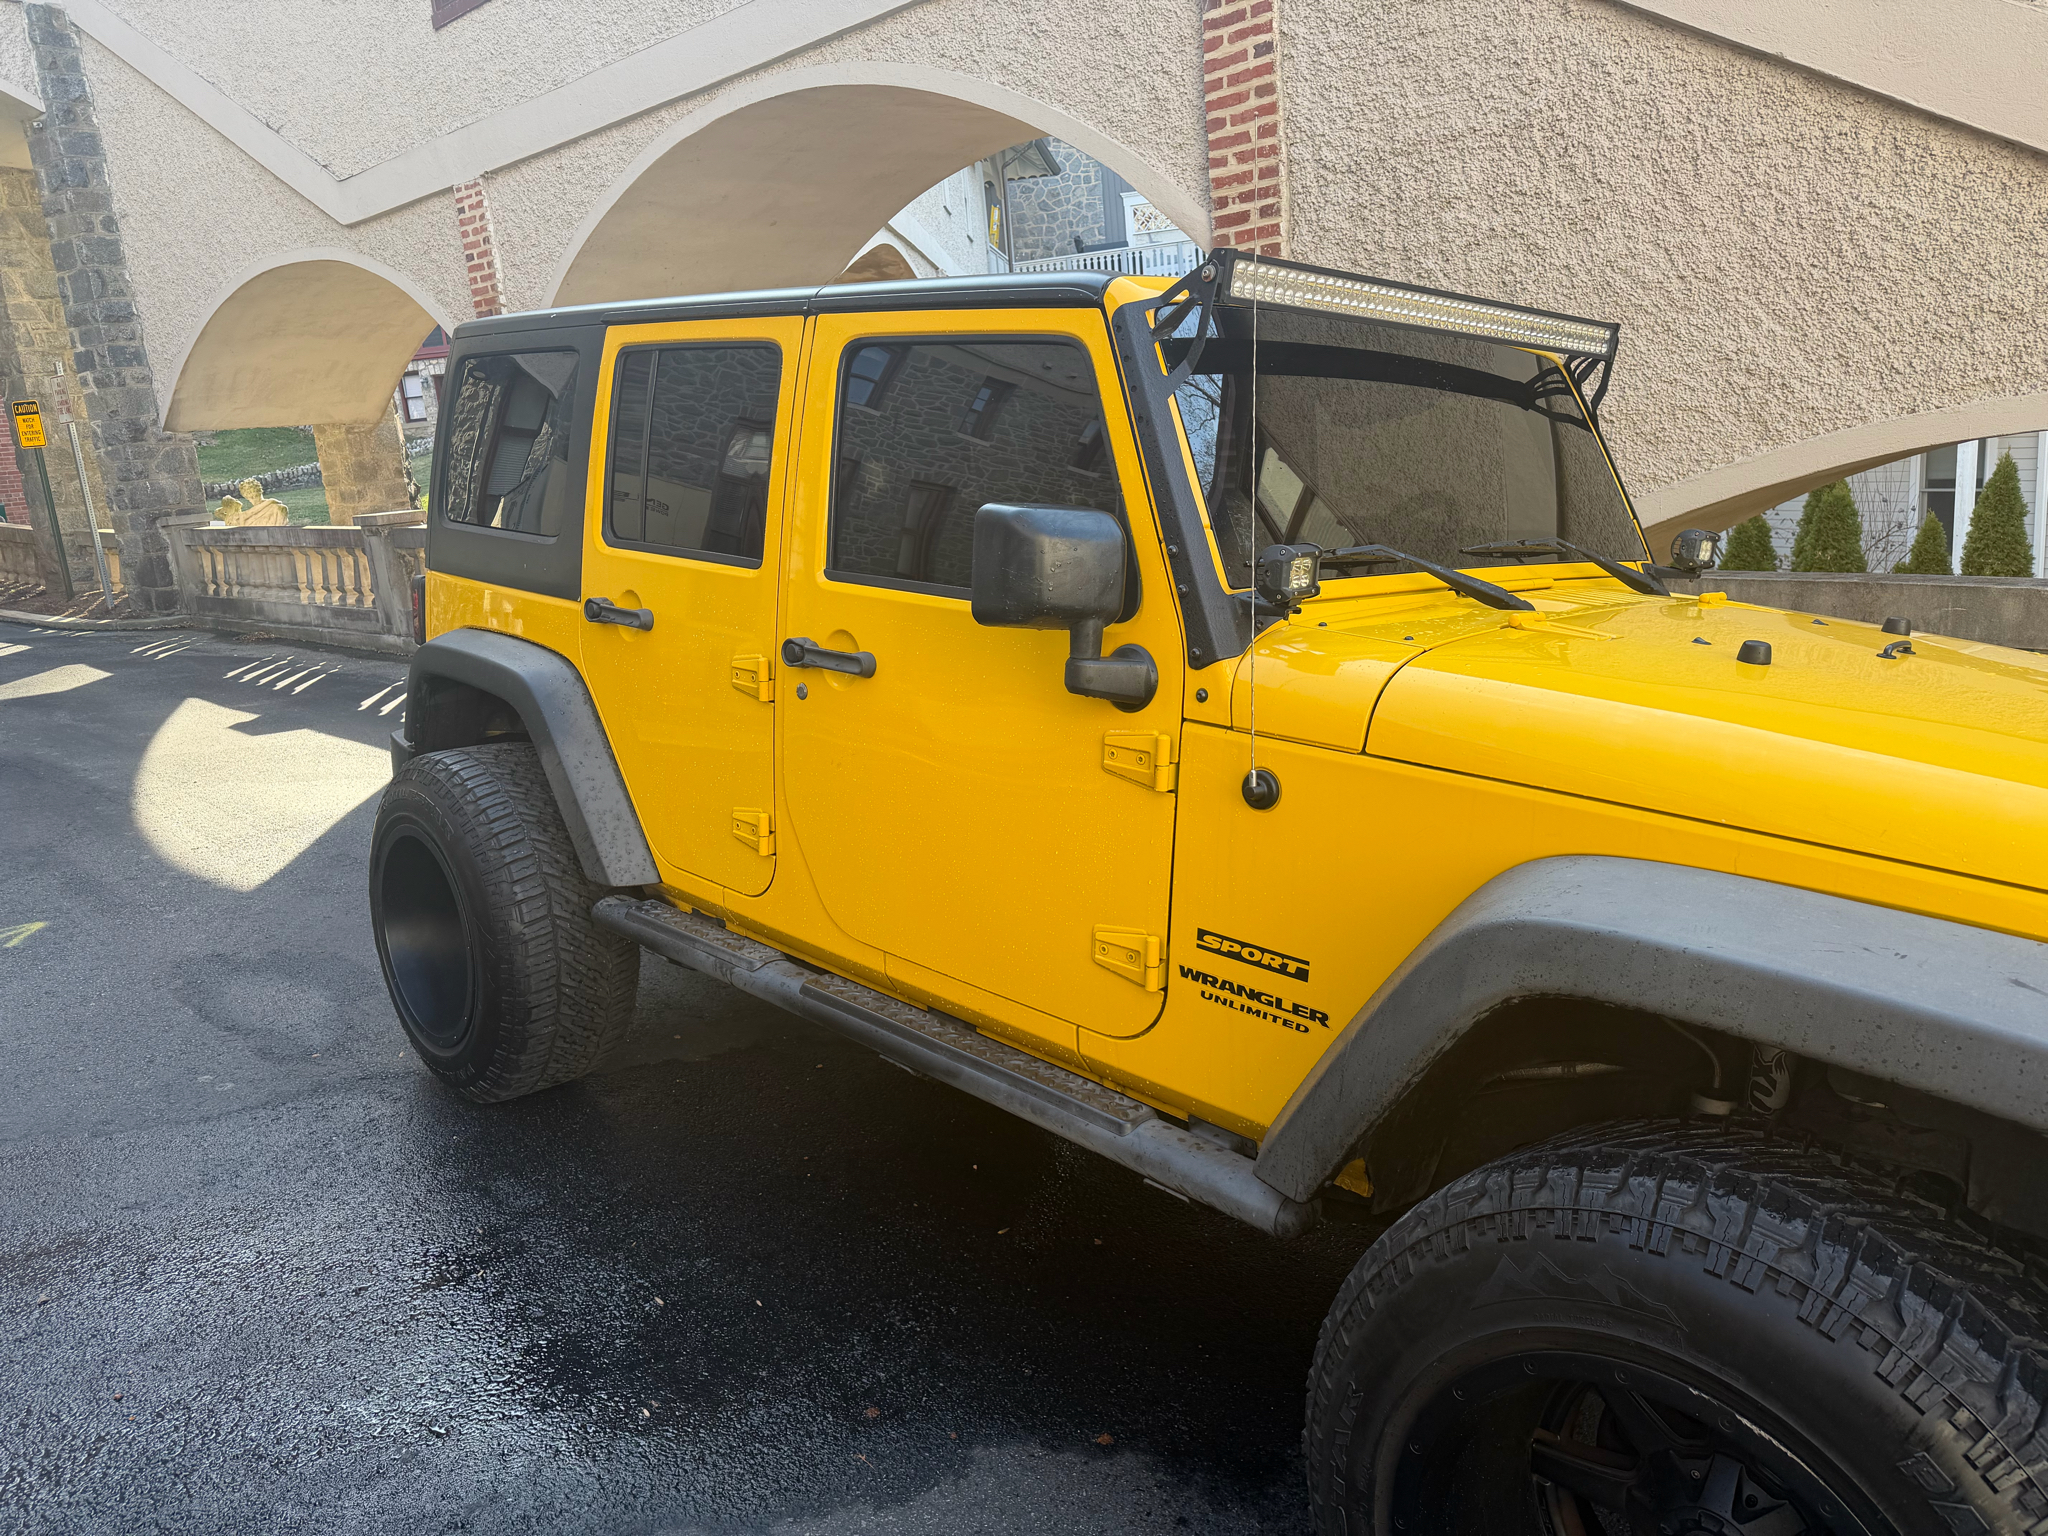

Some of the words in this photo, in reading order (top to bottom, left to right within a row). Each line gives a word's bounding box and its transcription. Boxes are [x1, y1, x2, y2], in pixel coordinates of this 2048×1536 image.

[14, 403, 38, 413] CAUTION
[1197, 934, 1310, 975] SPORT
[1178, 964, 1331, 1030] WRANGLER
[1200, 990, 1310, 1034] UNLIMITED
